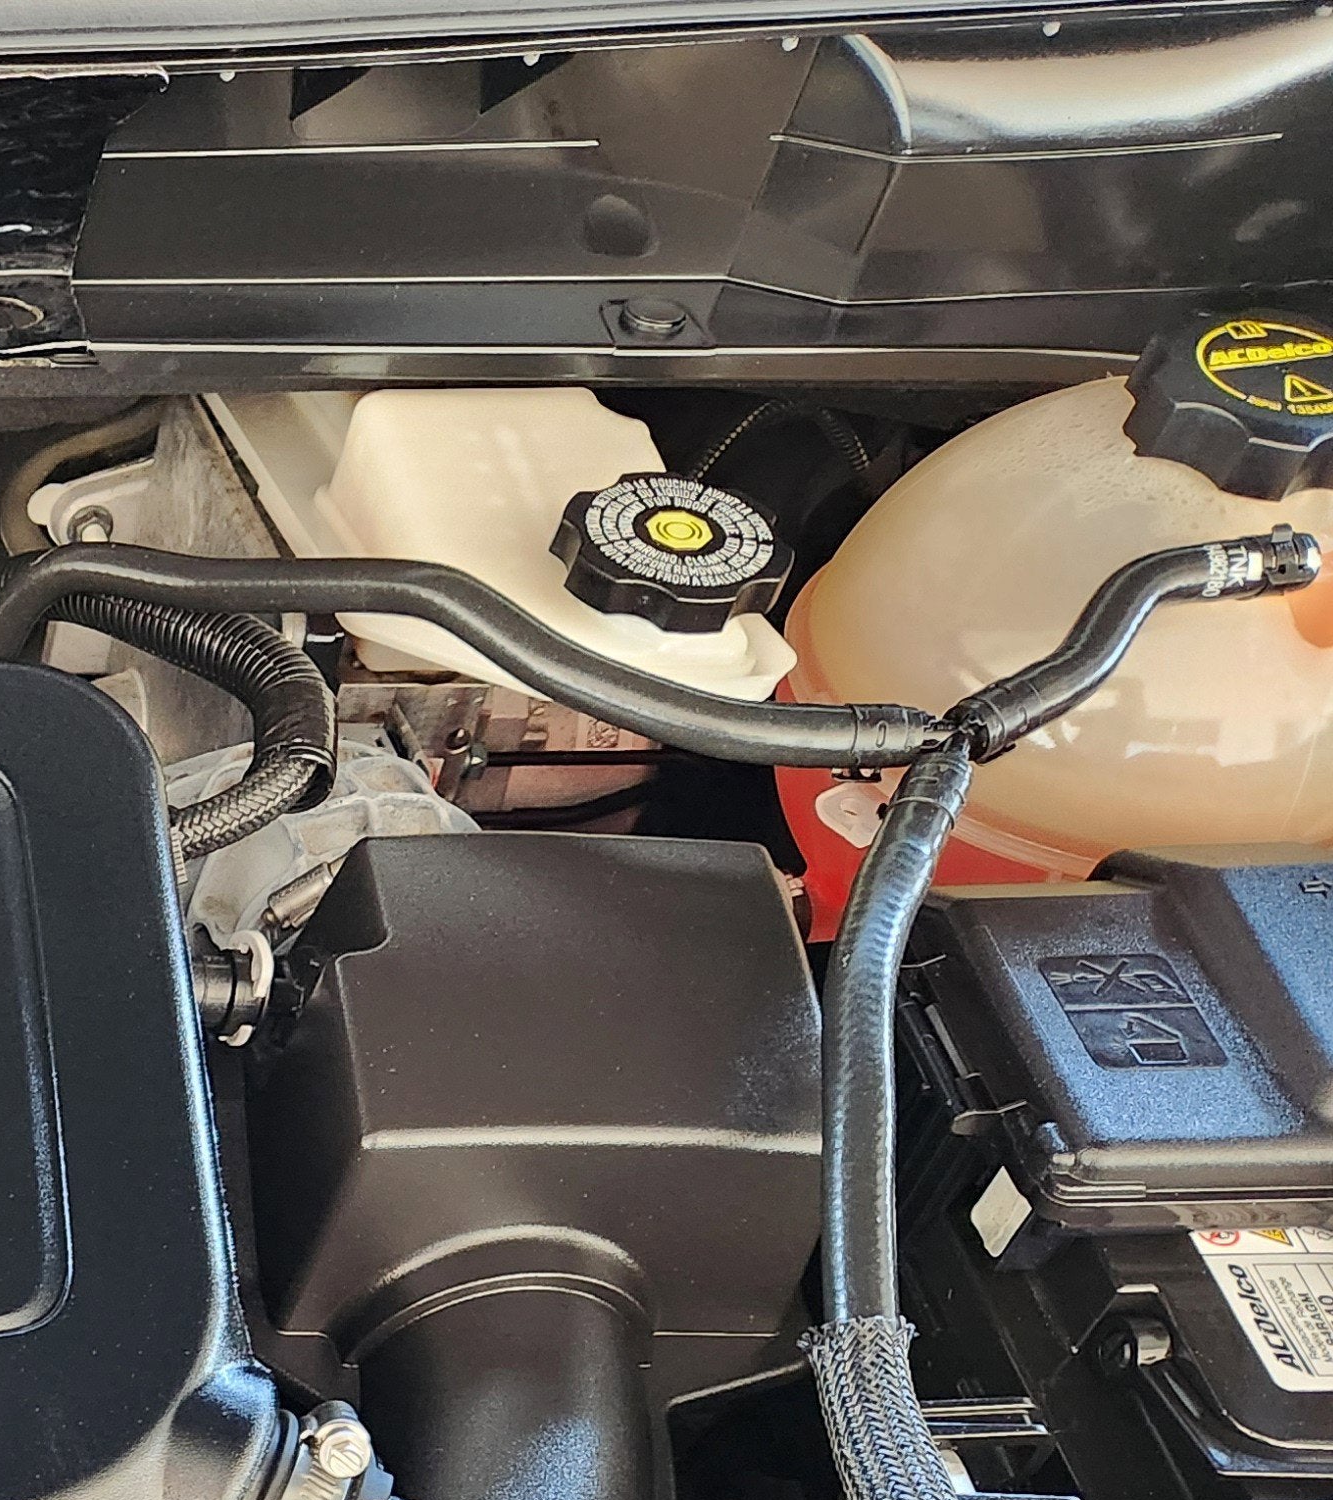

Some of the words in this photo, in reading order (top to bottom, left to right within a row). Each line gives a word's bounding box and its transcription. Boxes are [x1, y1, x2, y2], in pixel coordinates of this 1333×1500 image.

[1209, 342, 1333, 365] ACDelco
[650, 477, 703, 493] BOUCHON
[1225, 545, 1249, 587] TNK
[1227, 1263, 1304, 1373] ACDelco
